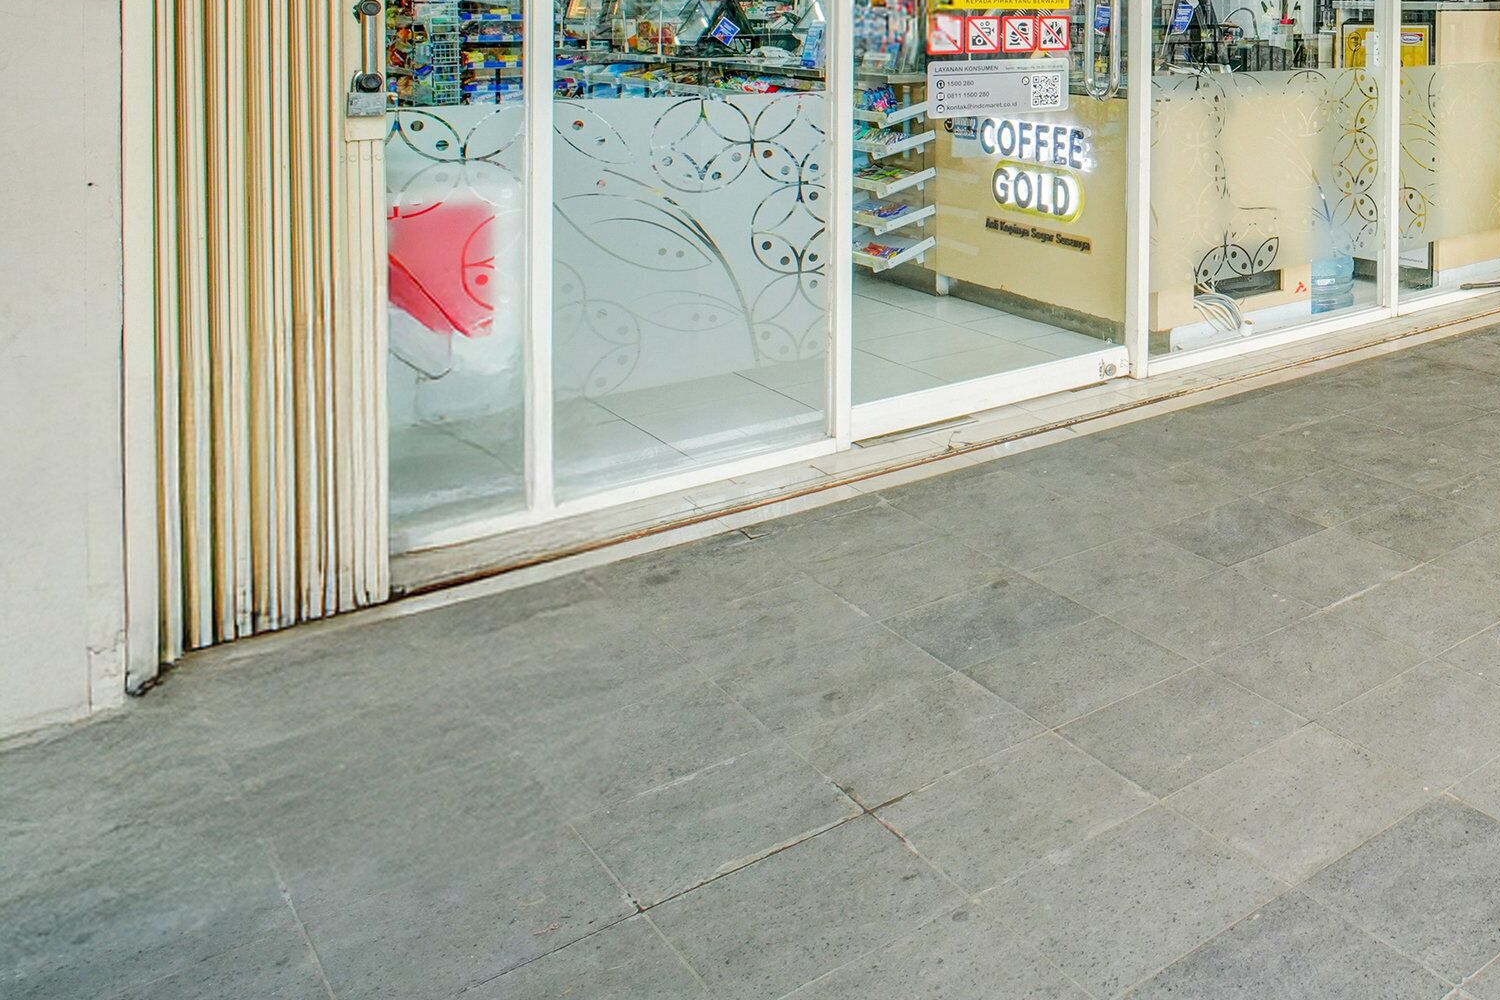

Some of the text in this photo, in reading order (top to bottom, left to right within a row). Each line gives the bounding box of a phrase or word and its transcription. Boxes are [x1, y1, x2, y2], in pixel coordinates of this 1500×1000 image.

[946, 101, 1018, 111] kontak@indomaret.co.id
[980, 118, 1085, 170] COFFEE
[992, 167, 1070, 216] GOLD
